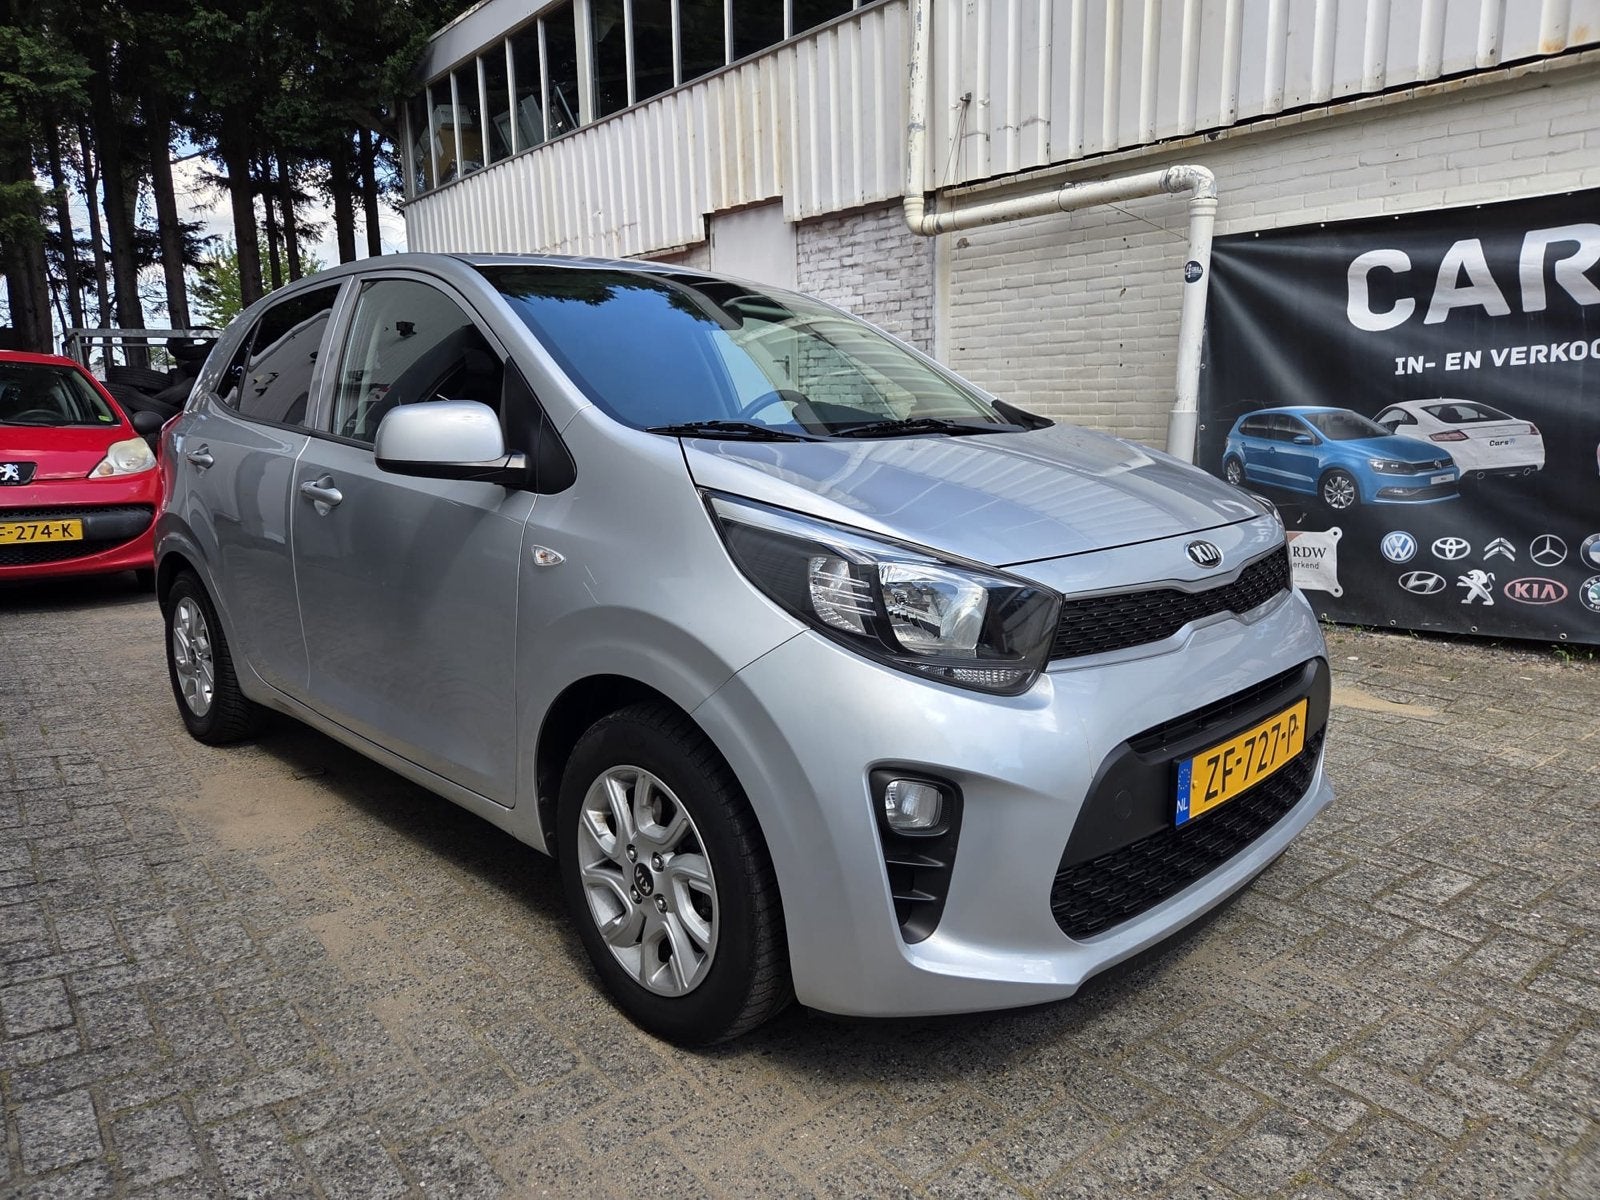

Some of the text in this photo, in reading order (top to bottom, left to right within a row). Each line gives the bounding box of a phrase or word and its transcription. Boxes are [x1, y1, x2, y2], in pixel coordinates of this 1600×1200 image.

[1347, 223, 1600, 332] CAR
[1394, 356, 1436, 375] IN-
[1445, 351, 1482, 371] EN
[1292, 546, 1327, 558] RDW
[1515, 583, 1556, 599] KIA
[1204, 713, 1299, 802] ZF-727-P
[1176, 797, 1188, 814] NL
